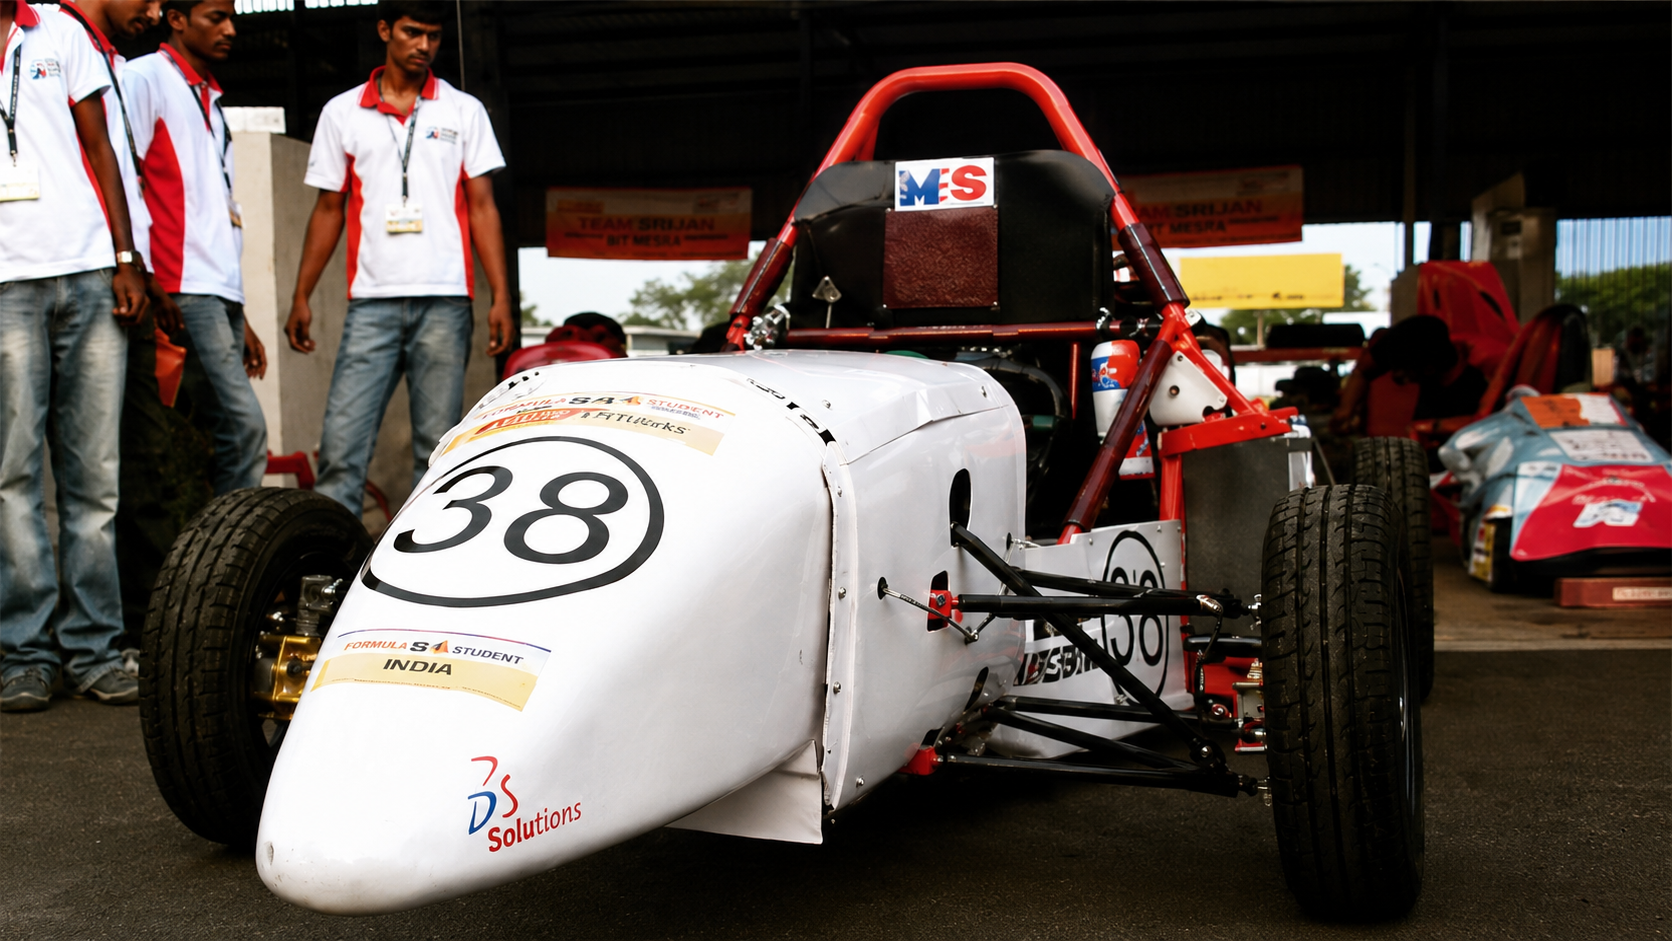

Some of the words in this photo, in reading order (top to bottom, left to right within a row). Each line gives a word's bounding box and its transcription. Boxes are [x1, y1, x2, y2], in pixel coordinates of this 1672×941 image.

[1175, 201, 1262, 217] SRIJAN
[578, 217, 632, 231] TEAM
[638, 216, 715, 231] SRIJAN
[607, 235, 629, 247] BIT
[633, 234, 681, 247] MESRA
[647, 399, 724, 419] STUDENT
[393, 465, 629, 564] 38
[344, 641, 408, 651] FORMULA
[452, 646, 524, 664] STUDENT
[383, 658, 452, 675] INDIA
[487, 802, 582, 852] Solutions
